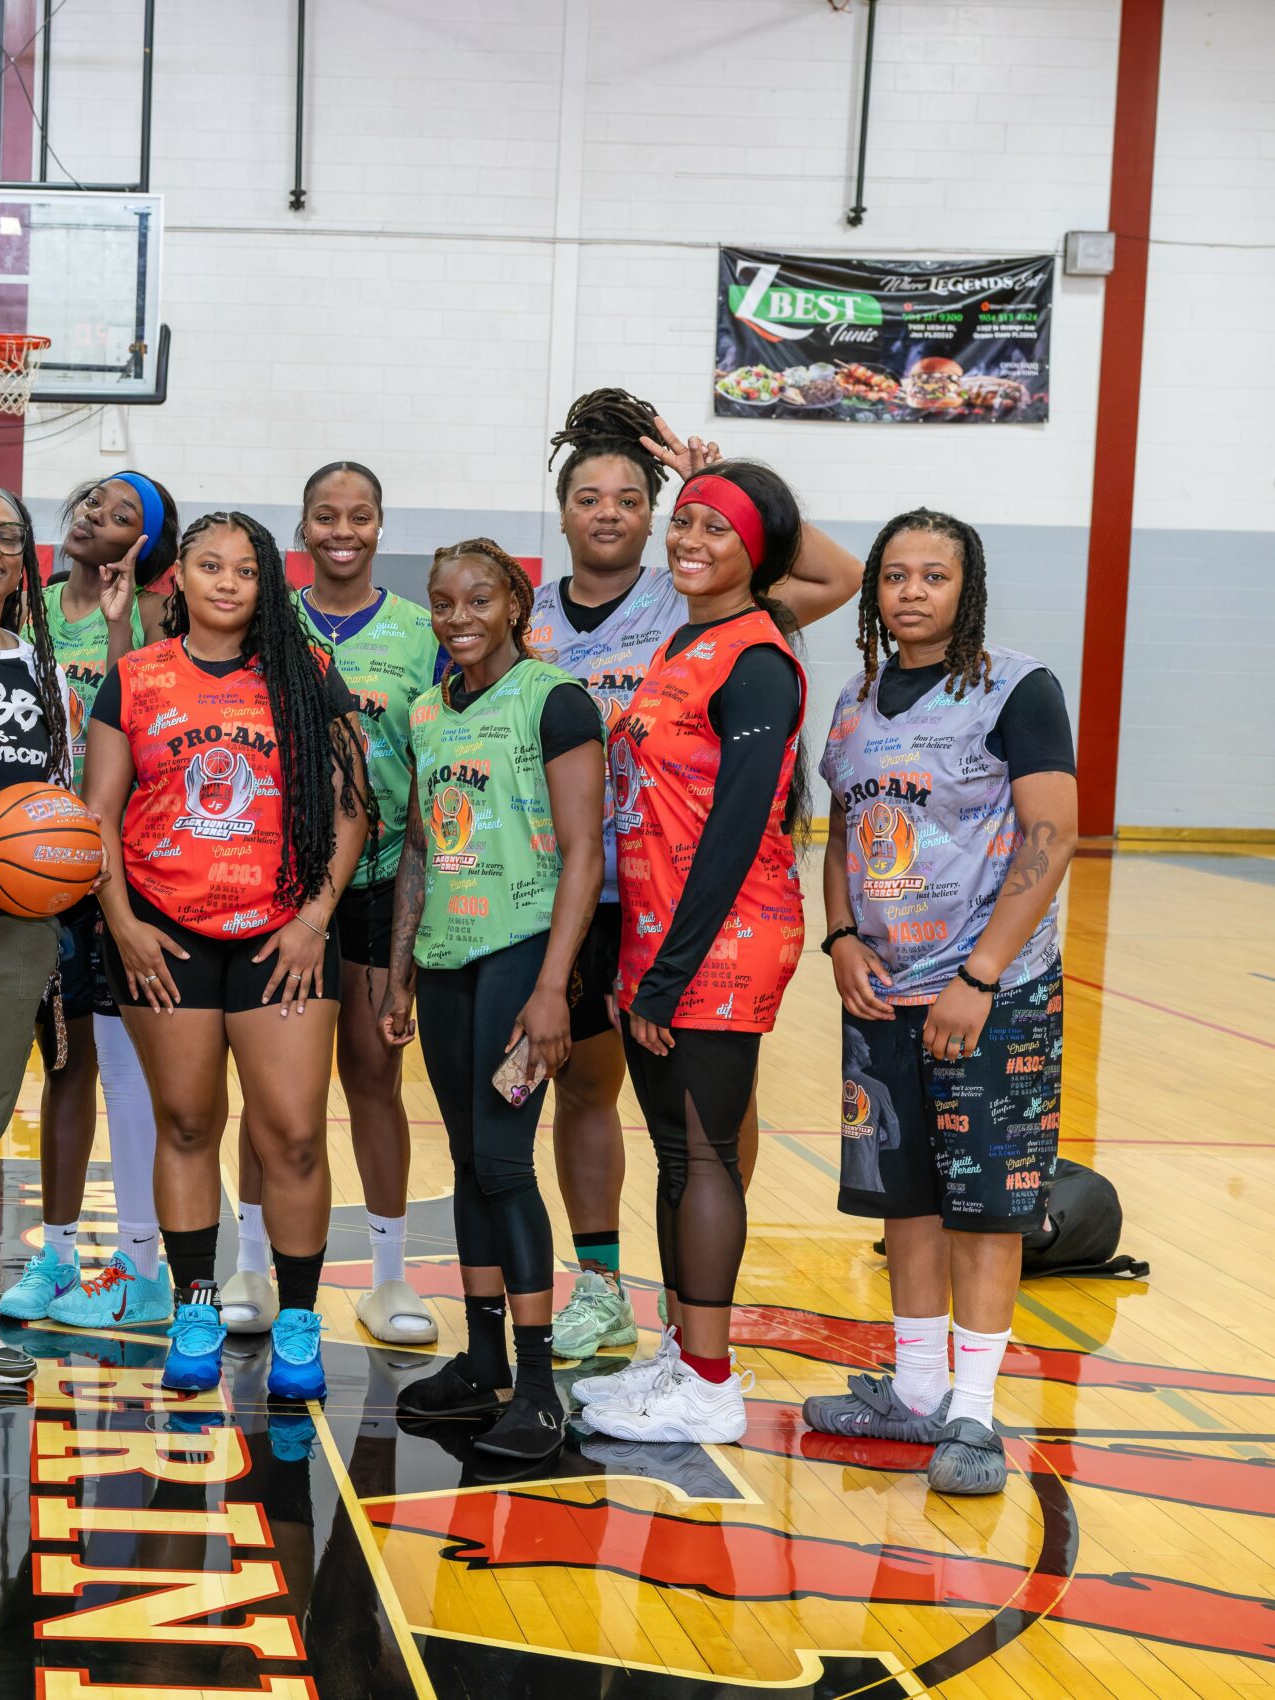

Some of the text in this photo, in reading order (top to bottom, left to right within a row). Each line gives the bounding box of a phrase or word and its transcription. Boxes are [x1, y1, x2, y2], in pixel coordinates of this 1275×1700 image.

[769, 291, 861, 323] BEST
[826, 320, 879, 346] Tunis
[621, 633, 639, 643] don't
[621, 635, 660, 648] just believe
[589, 649, 633, 669] Champs
[369, 659, 406, 674] don't worry,
[369, 666, 403, 679] just believe
[156, 707, 179, 724] built
[220, 706, 265, 719] Champs
[147, 713, 189, 736] different
[479, 725, 512, 734] don't worry,
[166, 723, 278, 760] PRO-AM
[477, 732, 509, 740] just believe
[866, 736, 900, 748] Long Live
[913, 733, 956, 743] don't worry,
[863, 742, 902, 755] Gy Coach
[910, 741, 953, 750] just believe
[879, 750, 921, 769] Champs
[958, 758, 963, 767] I
[427, 764, 490, 797] PRO-AM
[208, 800, 224, 810] JF
[959, 805, 982, 816] Long
[959, 812, 970, 822] Gy
[175, 818, 254, 832] JACKSONVILLE
[195, 827, 230, 838] FORCE
[242, 835, 278, 846] just believe
[485, 862, 505, 870] worry,
[874, 859, 888, 871] JF
[208, 861, 262, 886] #A303
[467, 868, 503, 877] just believe
[510, 883, 515, 891] I
[512, 886, 545, 901] therefore
[869, 887, 901, 897] FORCE
[916, 889, 959, 900] just believe
[448, 895, 490, 917] #A303
[884, 901, 929, 920] Champs
[177, 913, 213, 923] therefore
[233, 910, 259, 922] built
[223, 915, 269, 934] different
[993, 988, 1023, 1001] therefore
[1007, 1040, 1040, 1055] Champs
[962, 1090, 983, 1098] believe
[991, 1103, 1017, 1118] therefore
[951, 1155, 973, 1166] built
[1005, 1154, 1037, 1171] Champs
